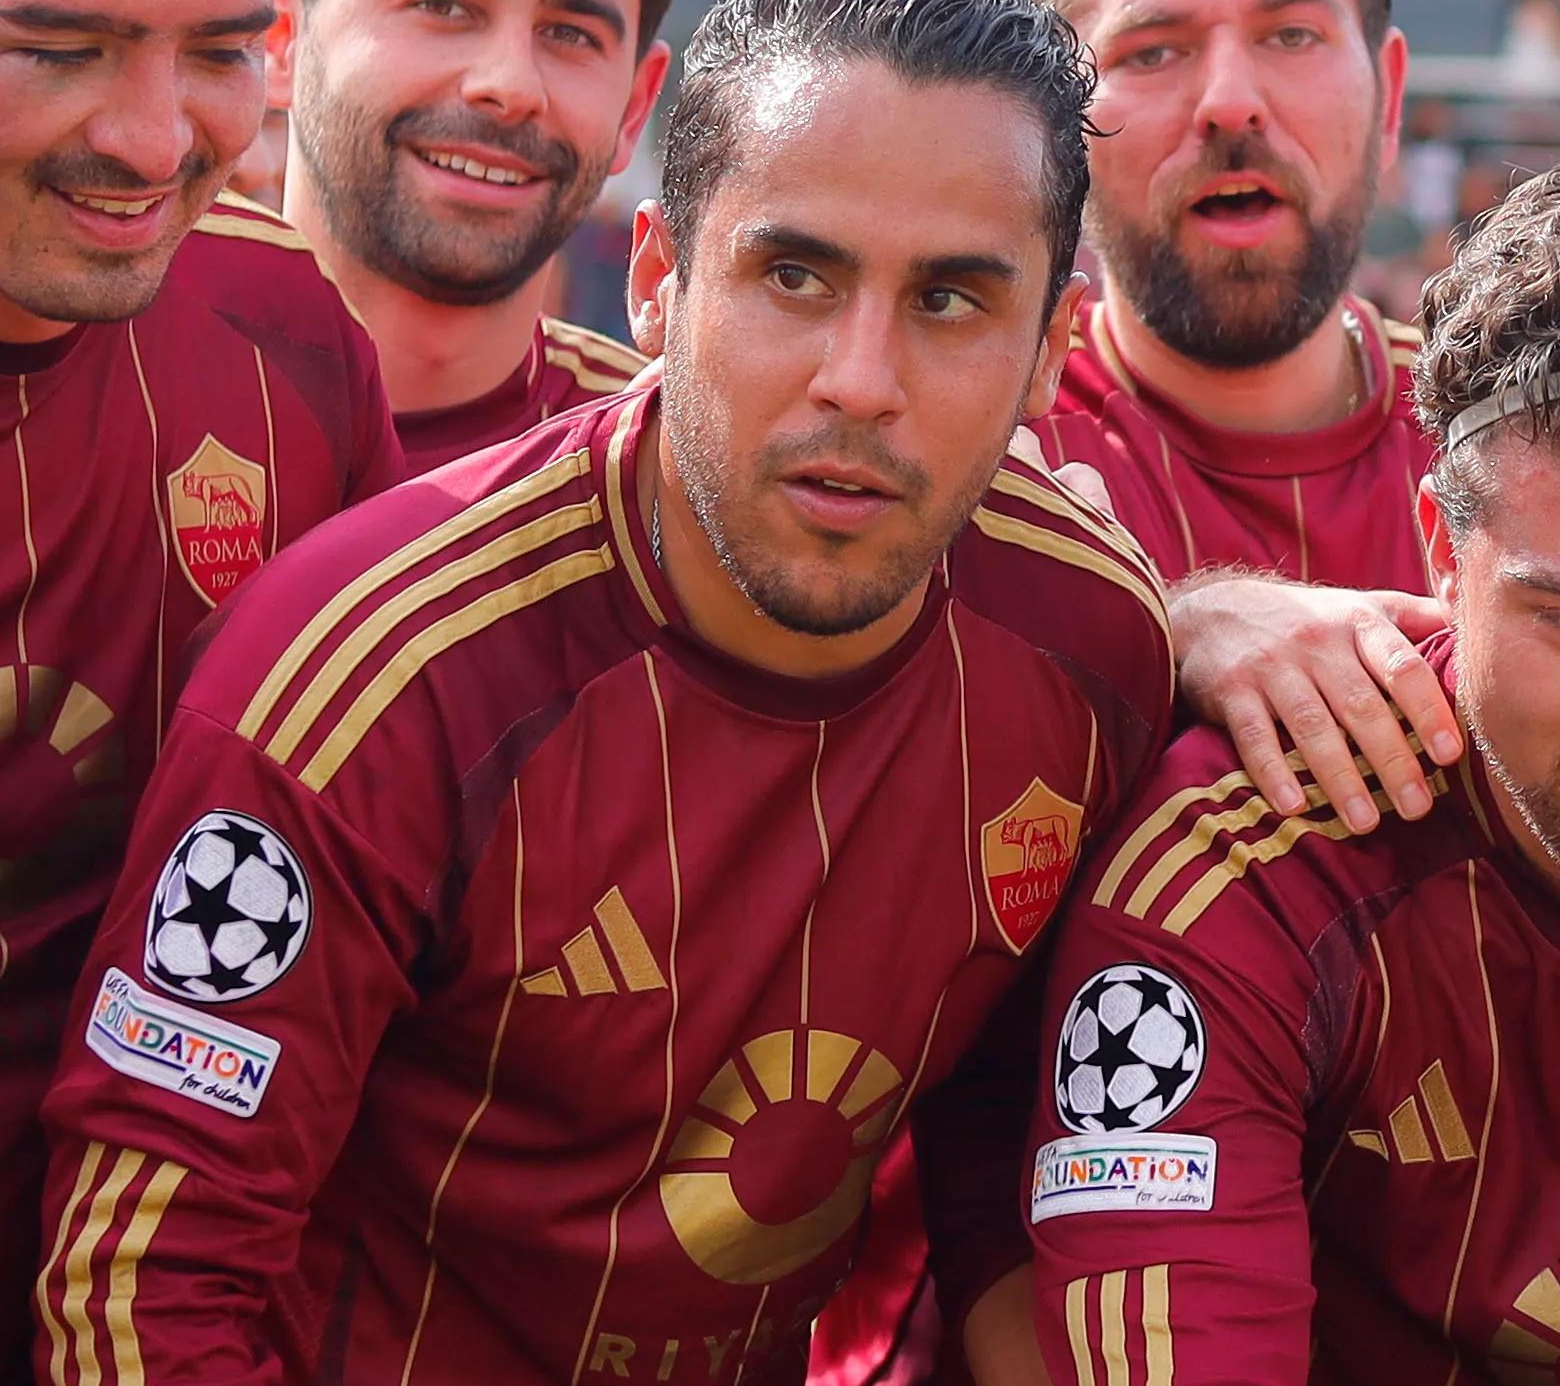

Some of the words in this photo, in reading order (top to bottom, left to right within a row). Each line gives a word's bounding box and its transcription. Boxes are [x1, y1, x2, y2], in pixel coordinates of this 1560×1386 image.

[189, 535, 262, 566] ROMA
[211, 571, 239, 589] 1927
[1001, 875, 1063, 911] ROMA
[95, 993, 266, 1090] FOUNDATION
[178, 1073, 203, 1091] for
[204, 1085, 251, 1111] children
